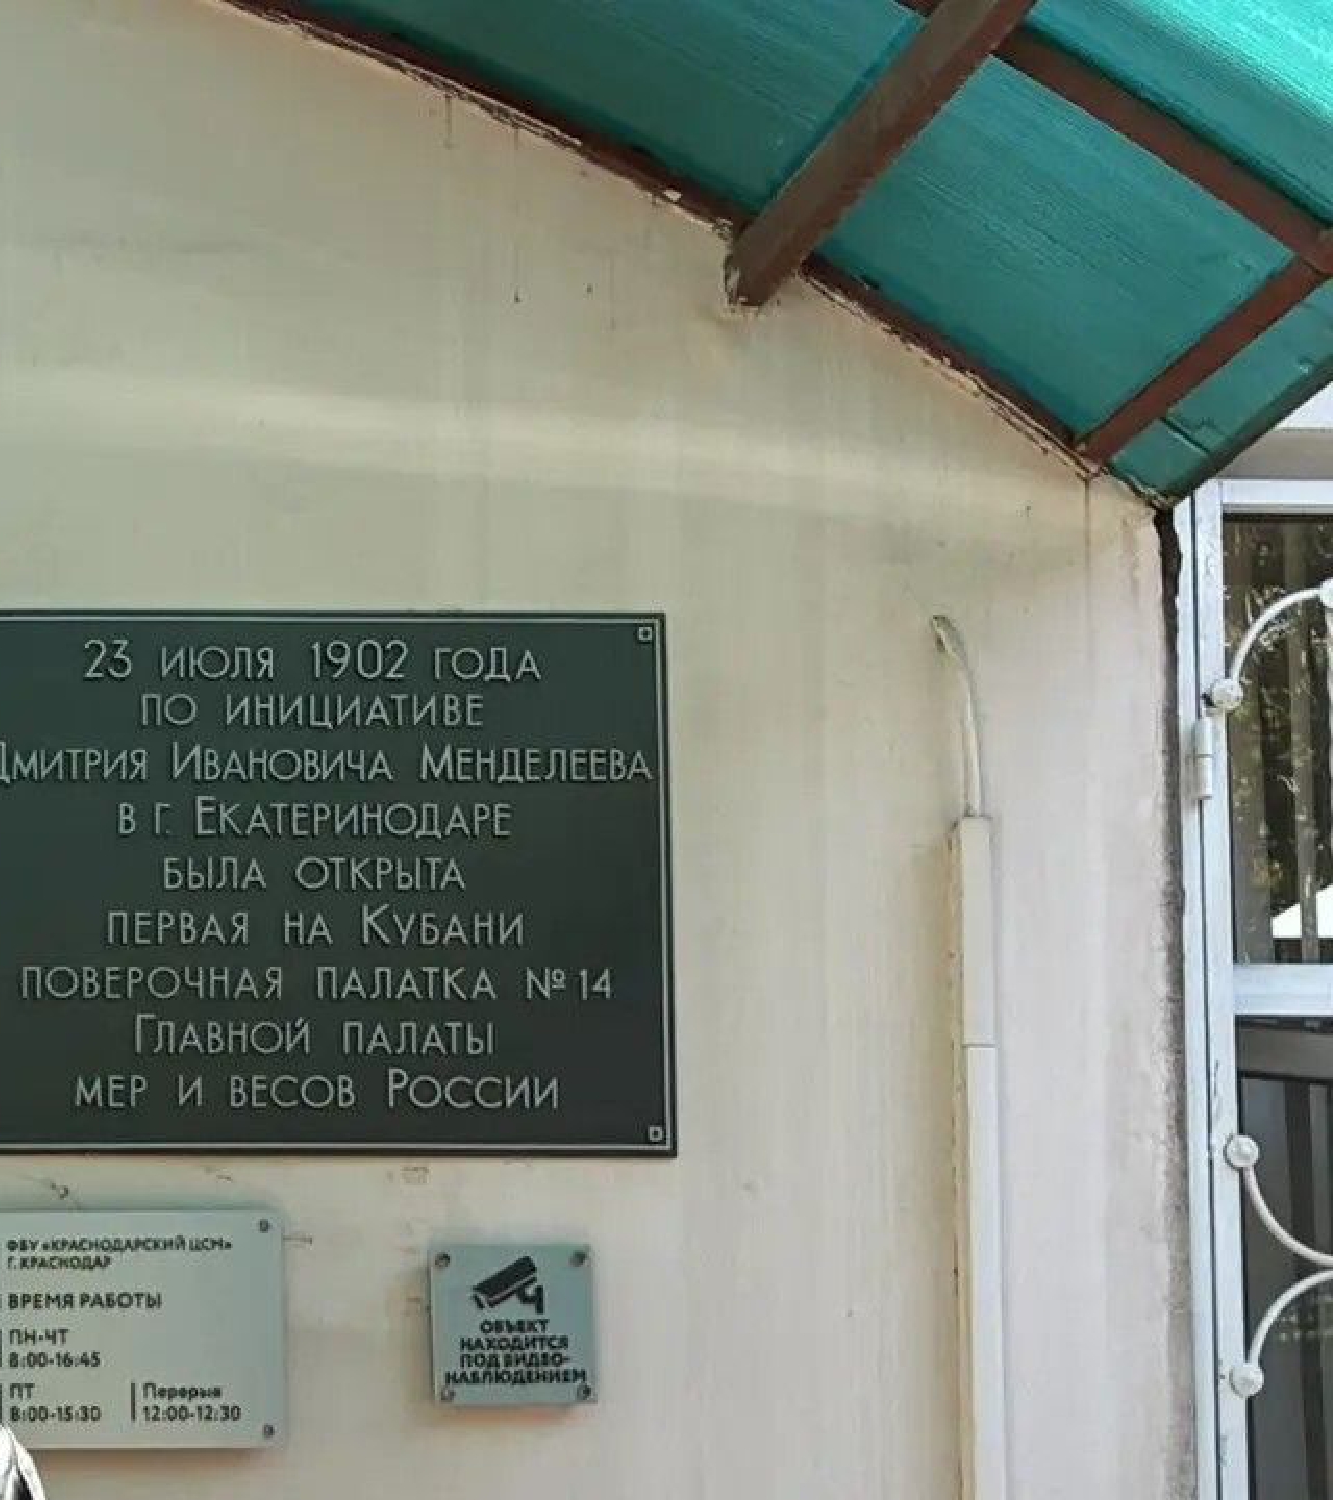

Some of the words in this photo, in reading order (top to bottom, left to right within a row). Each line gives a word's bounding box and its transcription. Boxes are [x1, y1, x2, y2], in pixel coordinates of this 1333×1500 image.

[85, 640, 131, 677] 23
[162, 646, 273, 677] ИЮЛЯ
[312, 640, 408, 679] 1902
[435, 648, 541, 681] ГОДА
[141, 694, 198, 725] ПО
[227, 694, 483, 727] ИНИЦИАТИВЕ
[120, 802, 135, 833] В
[164, 856, 266, 888] БЫЛА
[295, 856, 464, 890] ОТКРЫТА
[108, 910, 248, 944] ПЕРВАЯ
[285, 913, 333, 944] НА
[23, 967, 281, 998] ПОВЕРОЧНАЯ
[318, 967, 495, 998] ПАЛАТКА
[343, 1021, 493, 1054] ПАЛАТЫ
[75, 1075, 148, 1106] МЕР
[179, 1075, 202, 1106] И
[231, 1075, 354, 1108] ВЕСОВ
[8, 1240, 39, 1252] ФБУ
[43, 1235, 185, 1252] «КРАСНОДАРСКИЙ
[189, 1238, 231, 1250] ЦСМ»
[20, 1256, 110, 1271] КРАСНОДАР
[8, 1294, 73, 1310] ВРЕМЯ
[79, 1292, 162, 1308] РАБОТЫ
[10, 1329, 68, 1344] ПН-ЧТ
[10, 1383, 35, 1400] ПТ
[143, 1406, 241, 1421] 12:00-12:30
